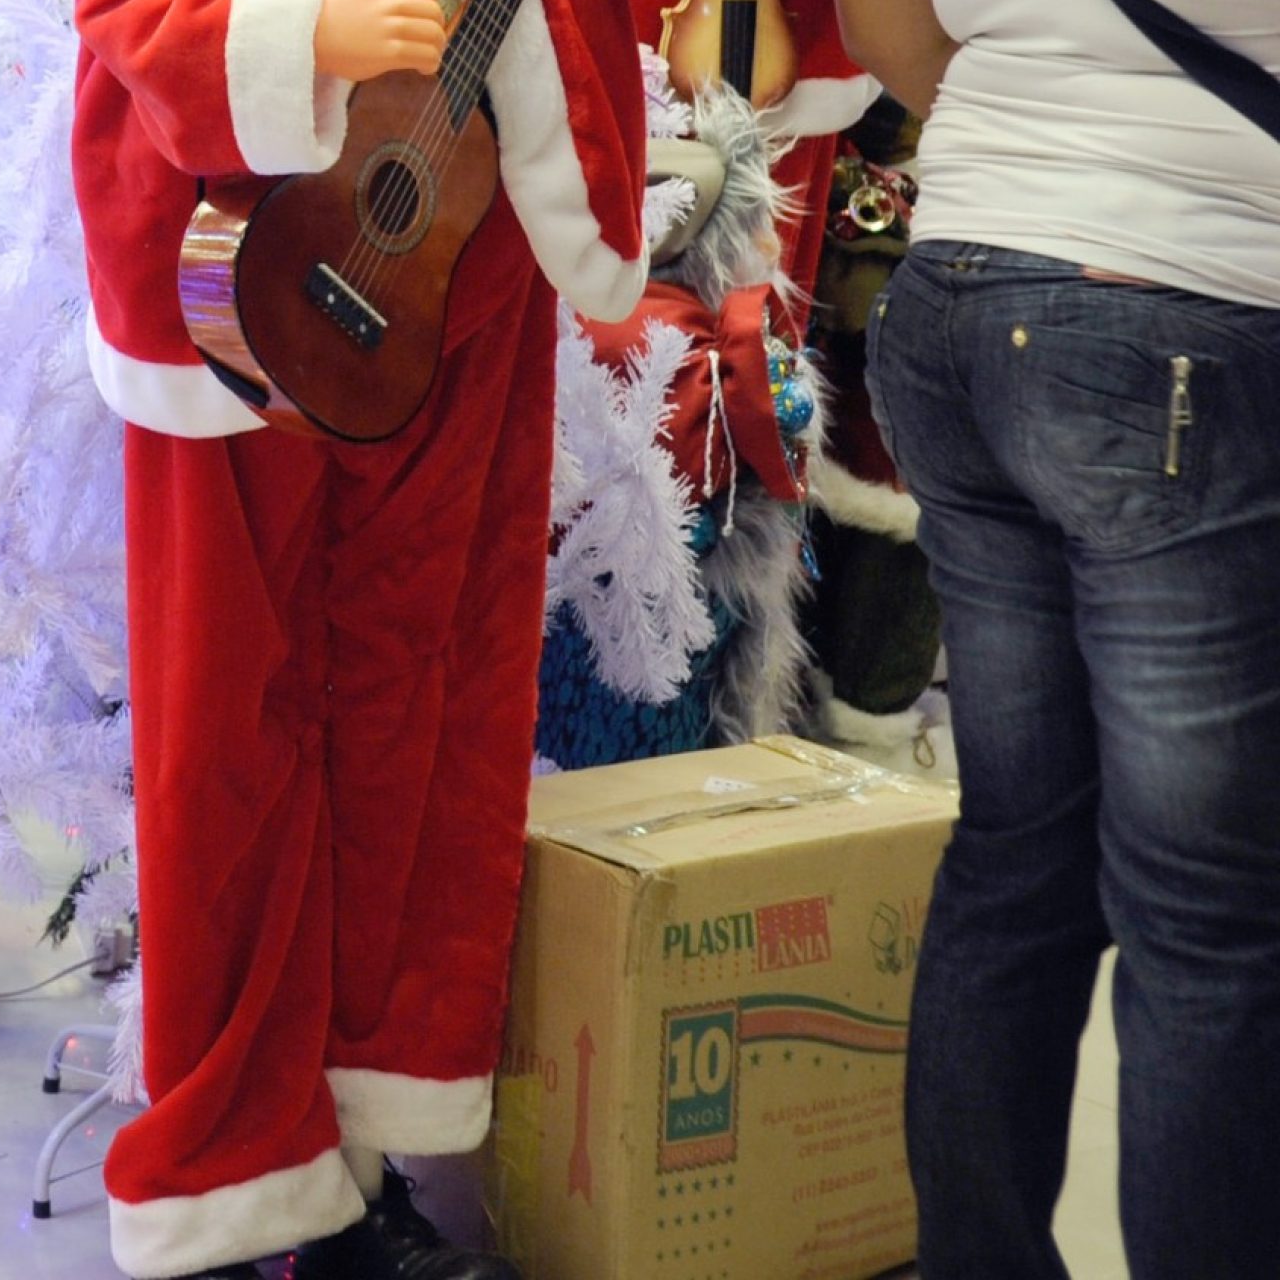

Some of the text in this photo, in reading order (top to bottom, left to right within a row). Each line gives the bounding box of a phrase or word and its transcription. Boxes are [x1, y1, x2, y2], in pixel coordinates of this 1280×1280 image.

[663, 912, 754, 960] PLASTI
[669, 1026, 730, 1100] 10
[674, 1105, 725, 1131] ANOS
